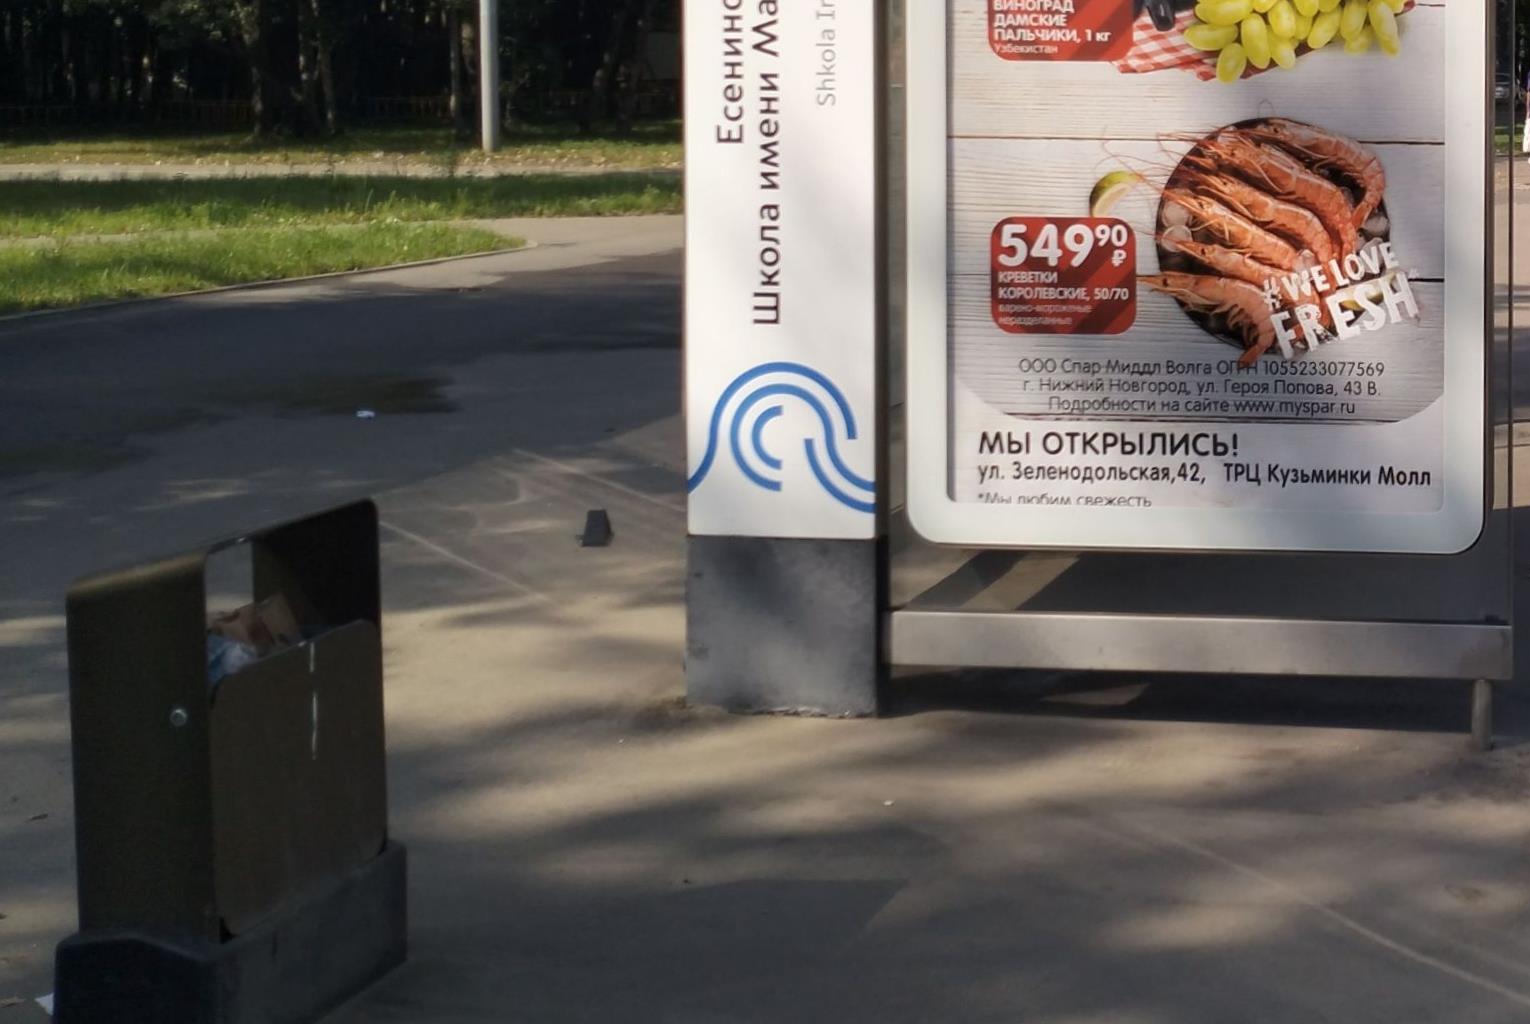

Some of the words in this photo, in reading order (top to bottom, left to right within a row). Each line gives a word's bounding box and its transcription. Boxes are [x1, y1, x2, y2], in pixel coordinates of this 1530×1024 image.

[993, 0, 1075, 13] ВИНОГРАД
[993, 14, 1068, 27] ДАМСКИЕ
[994, 28, 1081, 43] ПАЛЬЧИКИ,
[816, 29, 837, 106] Shkola
[759, 72, 780, 190] имени
[752, 204, 781, 325] Школа
[1328, 242, 1399, 288] LOVE
[998, 271, 1058, 284] КРЕВЕТКИ
[998, 287, 1090, 301] КОРОЛЕВСКИЕ,
[1094, 288, 1129, 301] 50/70
[1018, 358, 1057, 373] ООО
[1061, 358, 1101, 375] Спар
[1106, 360, 1161, 376] Миддл
[1165, 360, 1212, 375] Волга
[1216, 361, 1258, 375] ОГРН
[1264, 361, 1385, 376] 1055233077569
[1039, 378, 1104, 393] Нижний
[1109, 379, 1191, 395] Новгород,
[1197, 381, 1218, 395] ул.
[1224, 380, 1269, 394] Героя
[1274, 380, 1338, 396] Попова,
[1343, 381, 1362, 395] 43
[1048, 396, 1156, 414] Подробности
[1161, 399, 1180, 412] на
[1184, 398, 1230, 412] сайте
[1234, 401, 1355, 416] www.myspar.ru
[978, 431, 1031, 455] МЫ
[1042, 431, 1239, 456] ОТКРЫЛИСЬ!
[977, 464, 1005, 483] ул.
[1224, 463, 1261, 486] ТРЦ
[1267, 464, 1371, 488] Кузьминки
[1378, 466, 1432, 486] Молл
